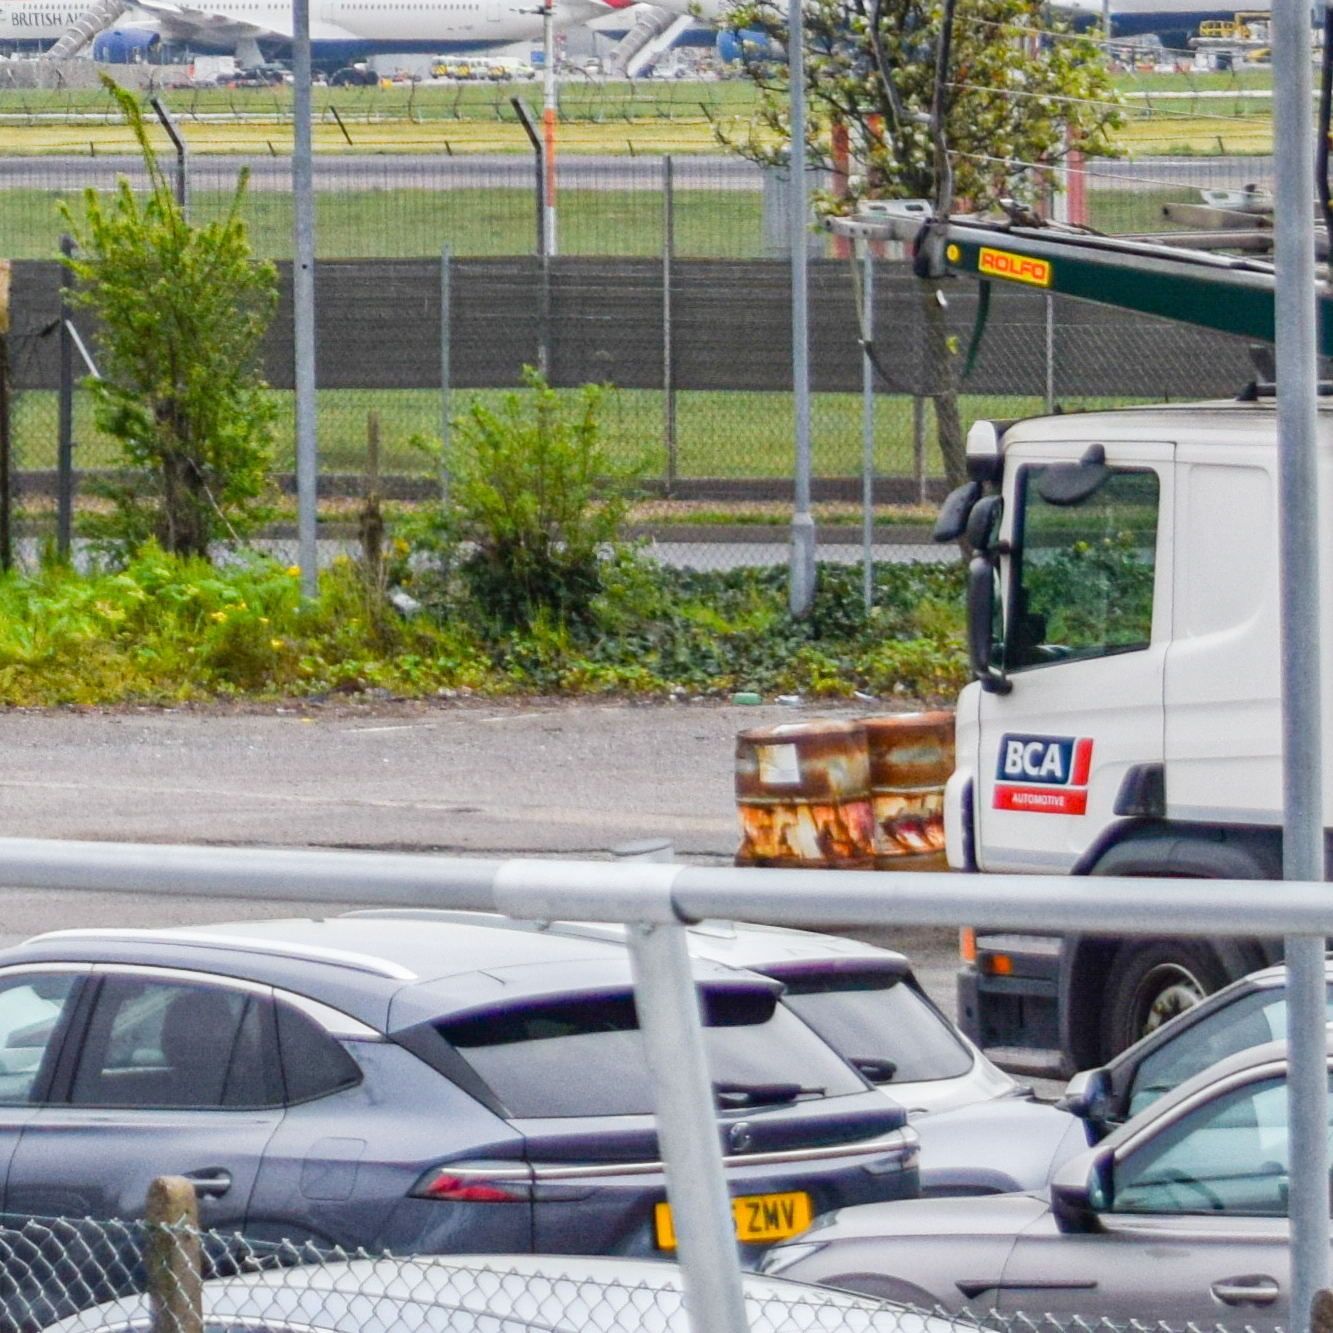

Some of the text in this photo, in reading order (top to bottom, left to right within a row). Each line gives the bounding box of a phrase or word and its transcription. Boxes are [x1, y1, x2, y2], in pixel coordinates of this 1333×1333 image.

[11, 12, 62, 27] BRITISH
[982, 252, 1046, 281] ROLFO
[1004, 740, 1063, 778] BCA
[1011, 792, 1065, 807] AUTOMOTIVE
[745, 1198, 795, 1233] ZMV
